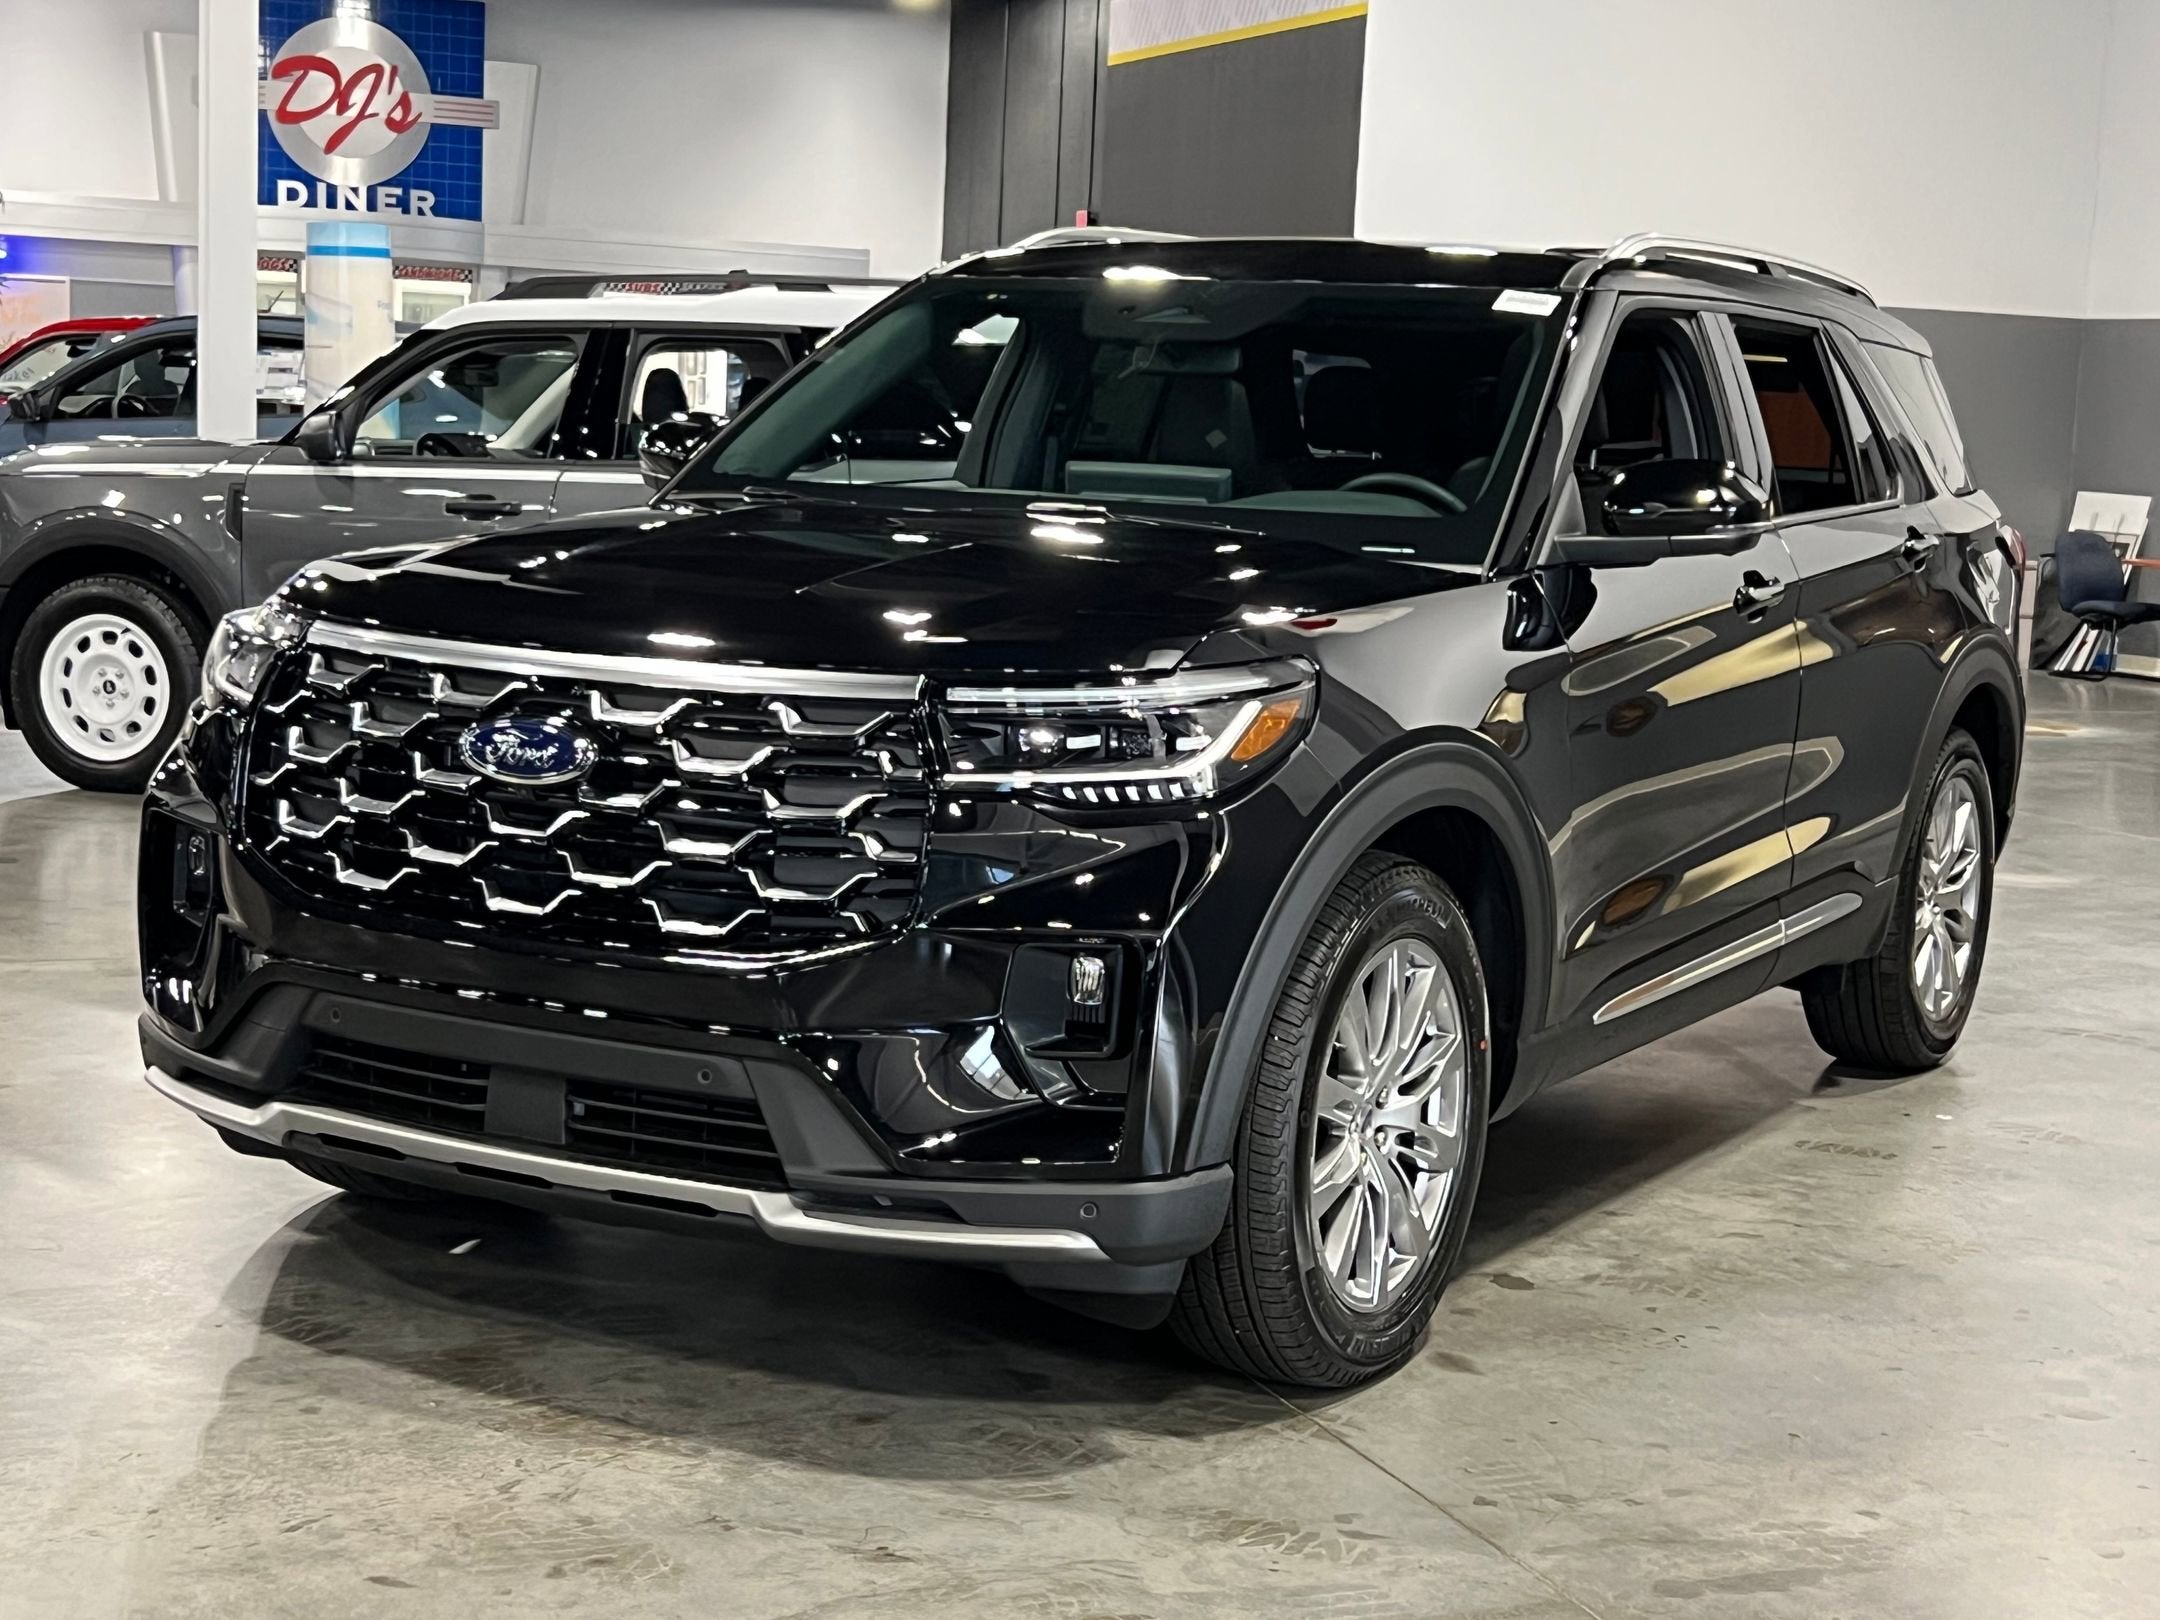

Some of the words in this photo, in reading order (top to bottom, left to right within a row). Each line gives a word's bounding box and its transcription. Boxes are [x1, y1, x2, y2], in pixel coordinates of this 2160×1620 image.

[271, 55, 423, 155] DJ's
[277, 179, 436, 217] DINER
[257, 257, 289, 271] OGS
[486, 730, 558, 768] Ford
